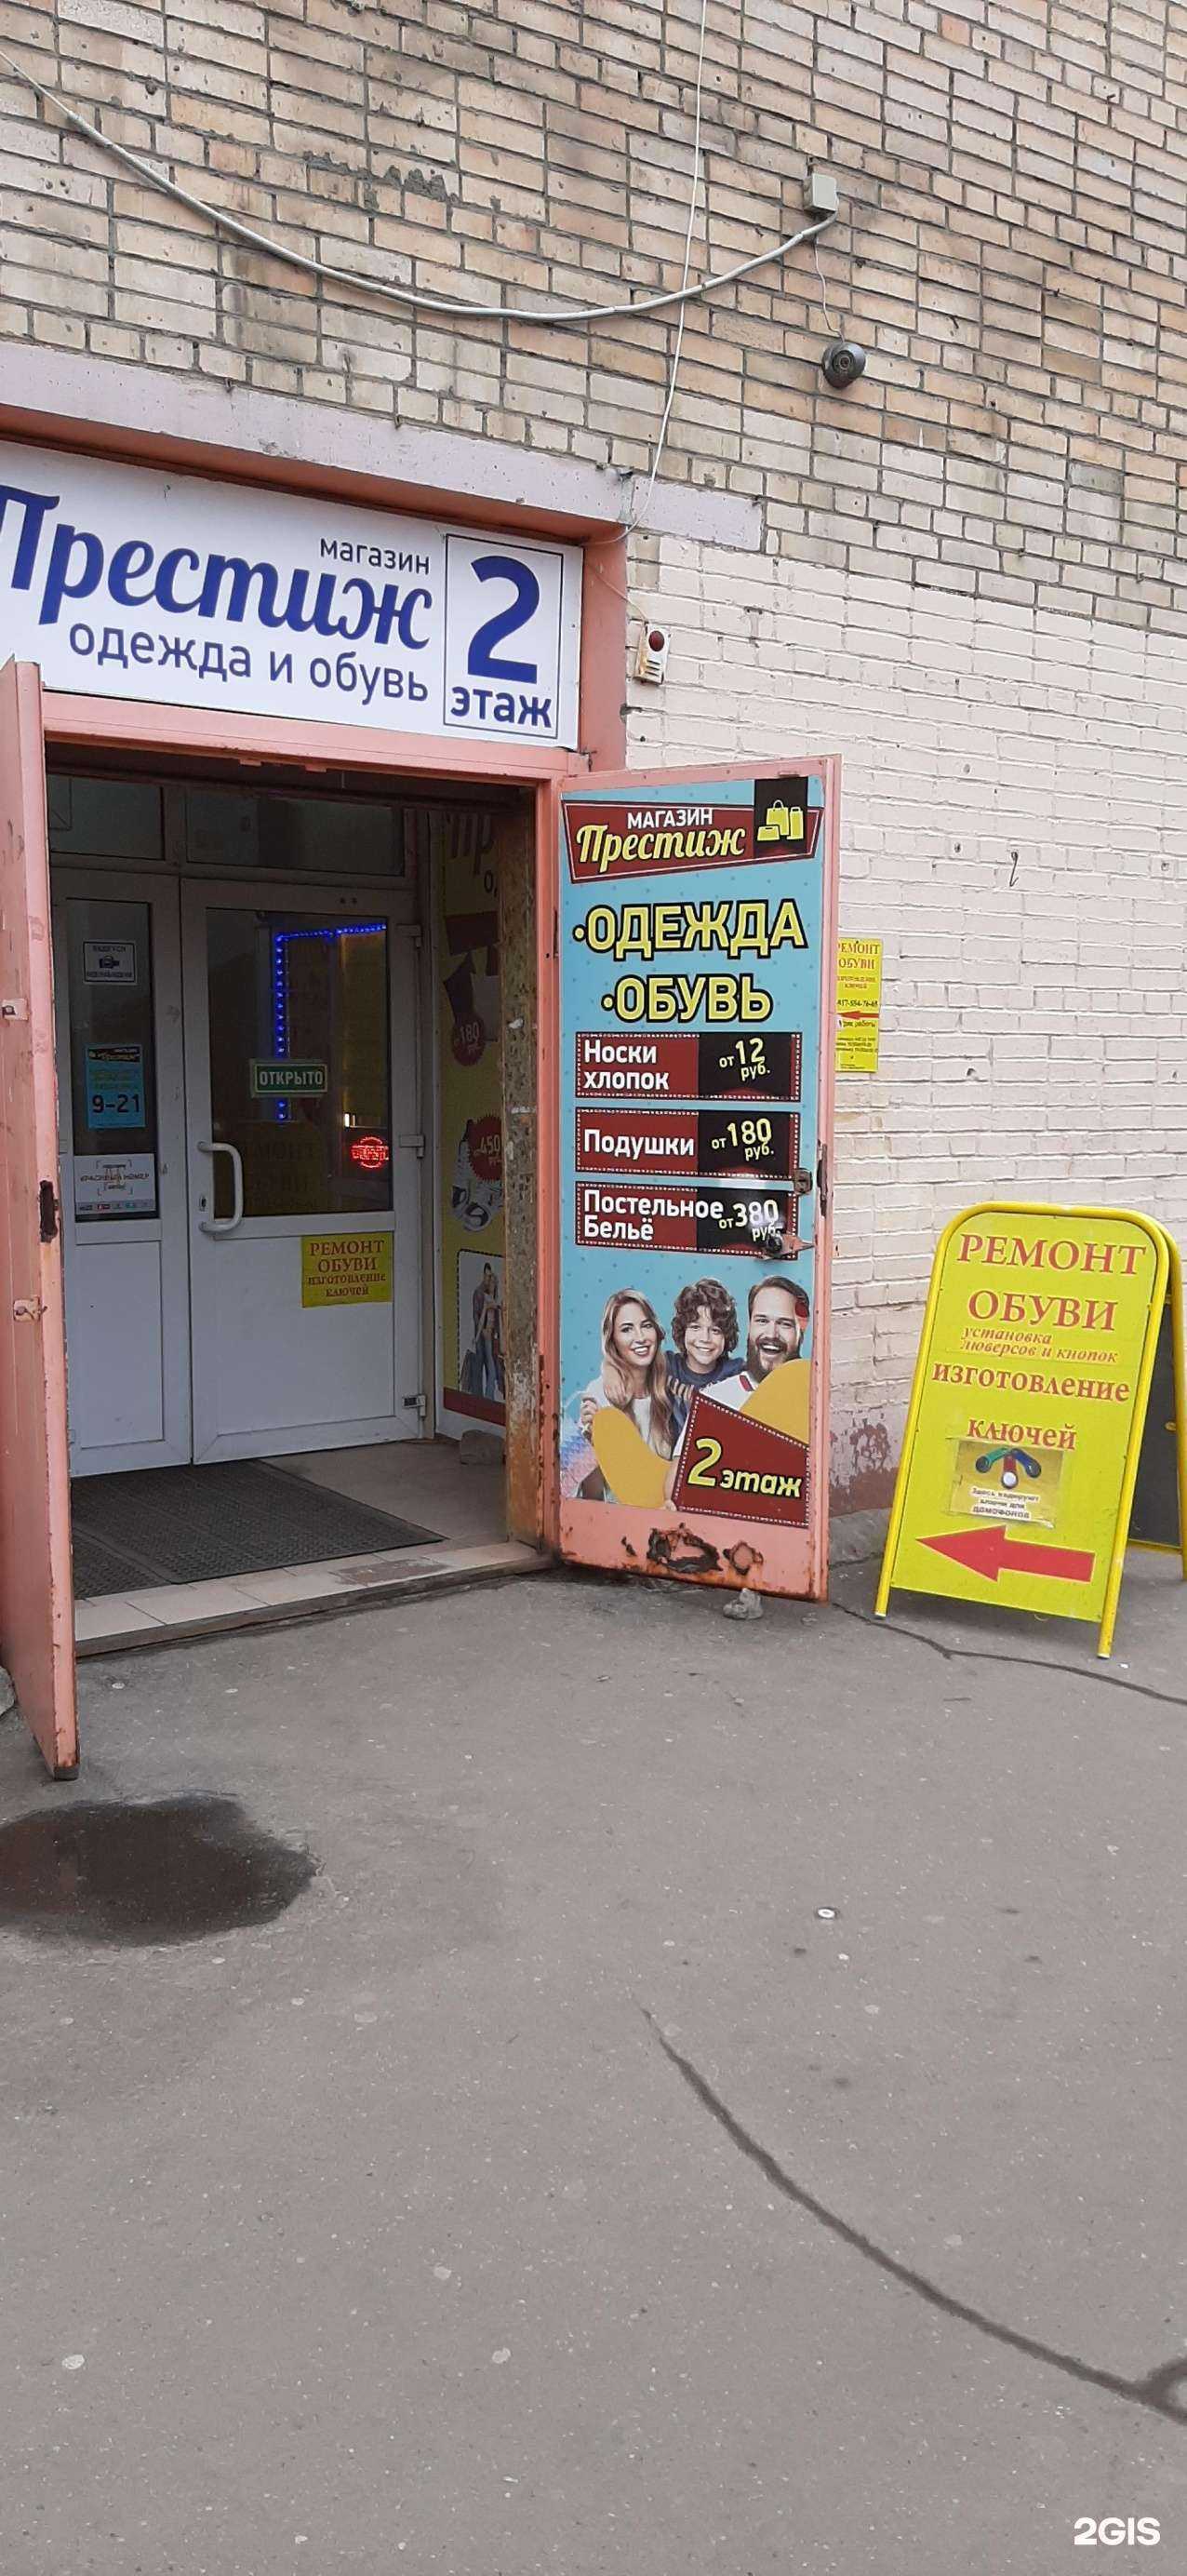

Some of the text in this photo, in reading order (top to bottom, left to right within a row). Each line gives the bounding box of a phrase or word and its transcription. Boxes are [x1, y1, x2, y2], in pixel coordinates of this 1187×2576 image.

[0, 483, 433, 650] Престиж
[319, 537, 431, 575] магазин
[467, 555, 540, 684] 2
[70, 623, 429, 705] одежда и обувь
[451, 685, 553, 729] этаж
[627, 808, 714, 829] МАГАЗИН
[576, 824, 746, 873] Престиж
[837, 944, 880, 955] ЕМОНТ
[583, 1039, 765, 1068] Носки от 12
[260, 1071, 324, 1086] ОТКРЫТО
[583, 1063, 771, 1092] хлопок руб.
[92, 1093, 140, 1114] 9-21
[583, 1119, 772, 1157] Подушки от 180
[744, 1145, 775, 1161] руб.
[583, 1189, 780, 1230] Постельное от 380
[583, 1214, 654, 1241] Бельё
[310, 1240, 385, 1256] РЕМОНТ
[955, 1234, 1147, 1276] РЕМОНТ
[318, 1257, 378, 1273] ОБУВИ
[967, 1290, 1117, 1332] ОБУВИ
[960, 1339, 1119, 1363] люверсов и кнопок
[961, 1326, 1053, 1346] установка
[931, 1362, 1131, 1402] изготовление
[967, 1417, 1078, 1450] ключей
[687, 1438, 802, 1497] 2 этаж
